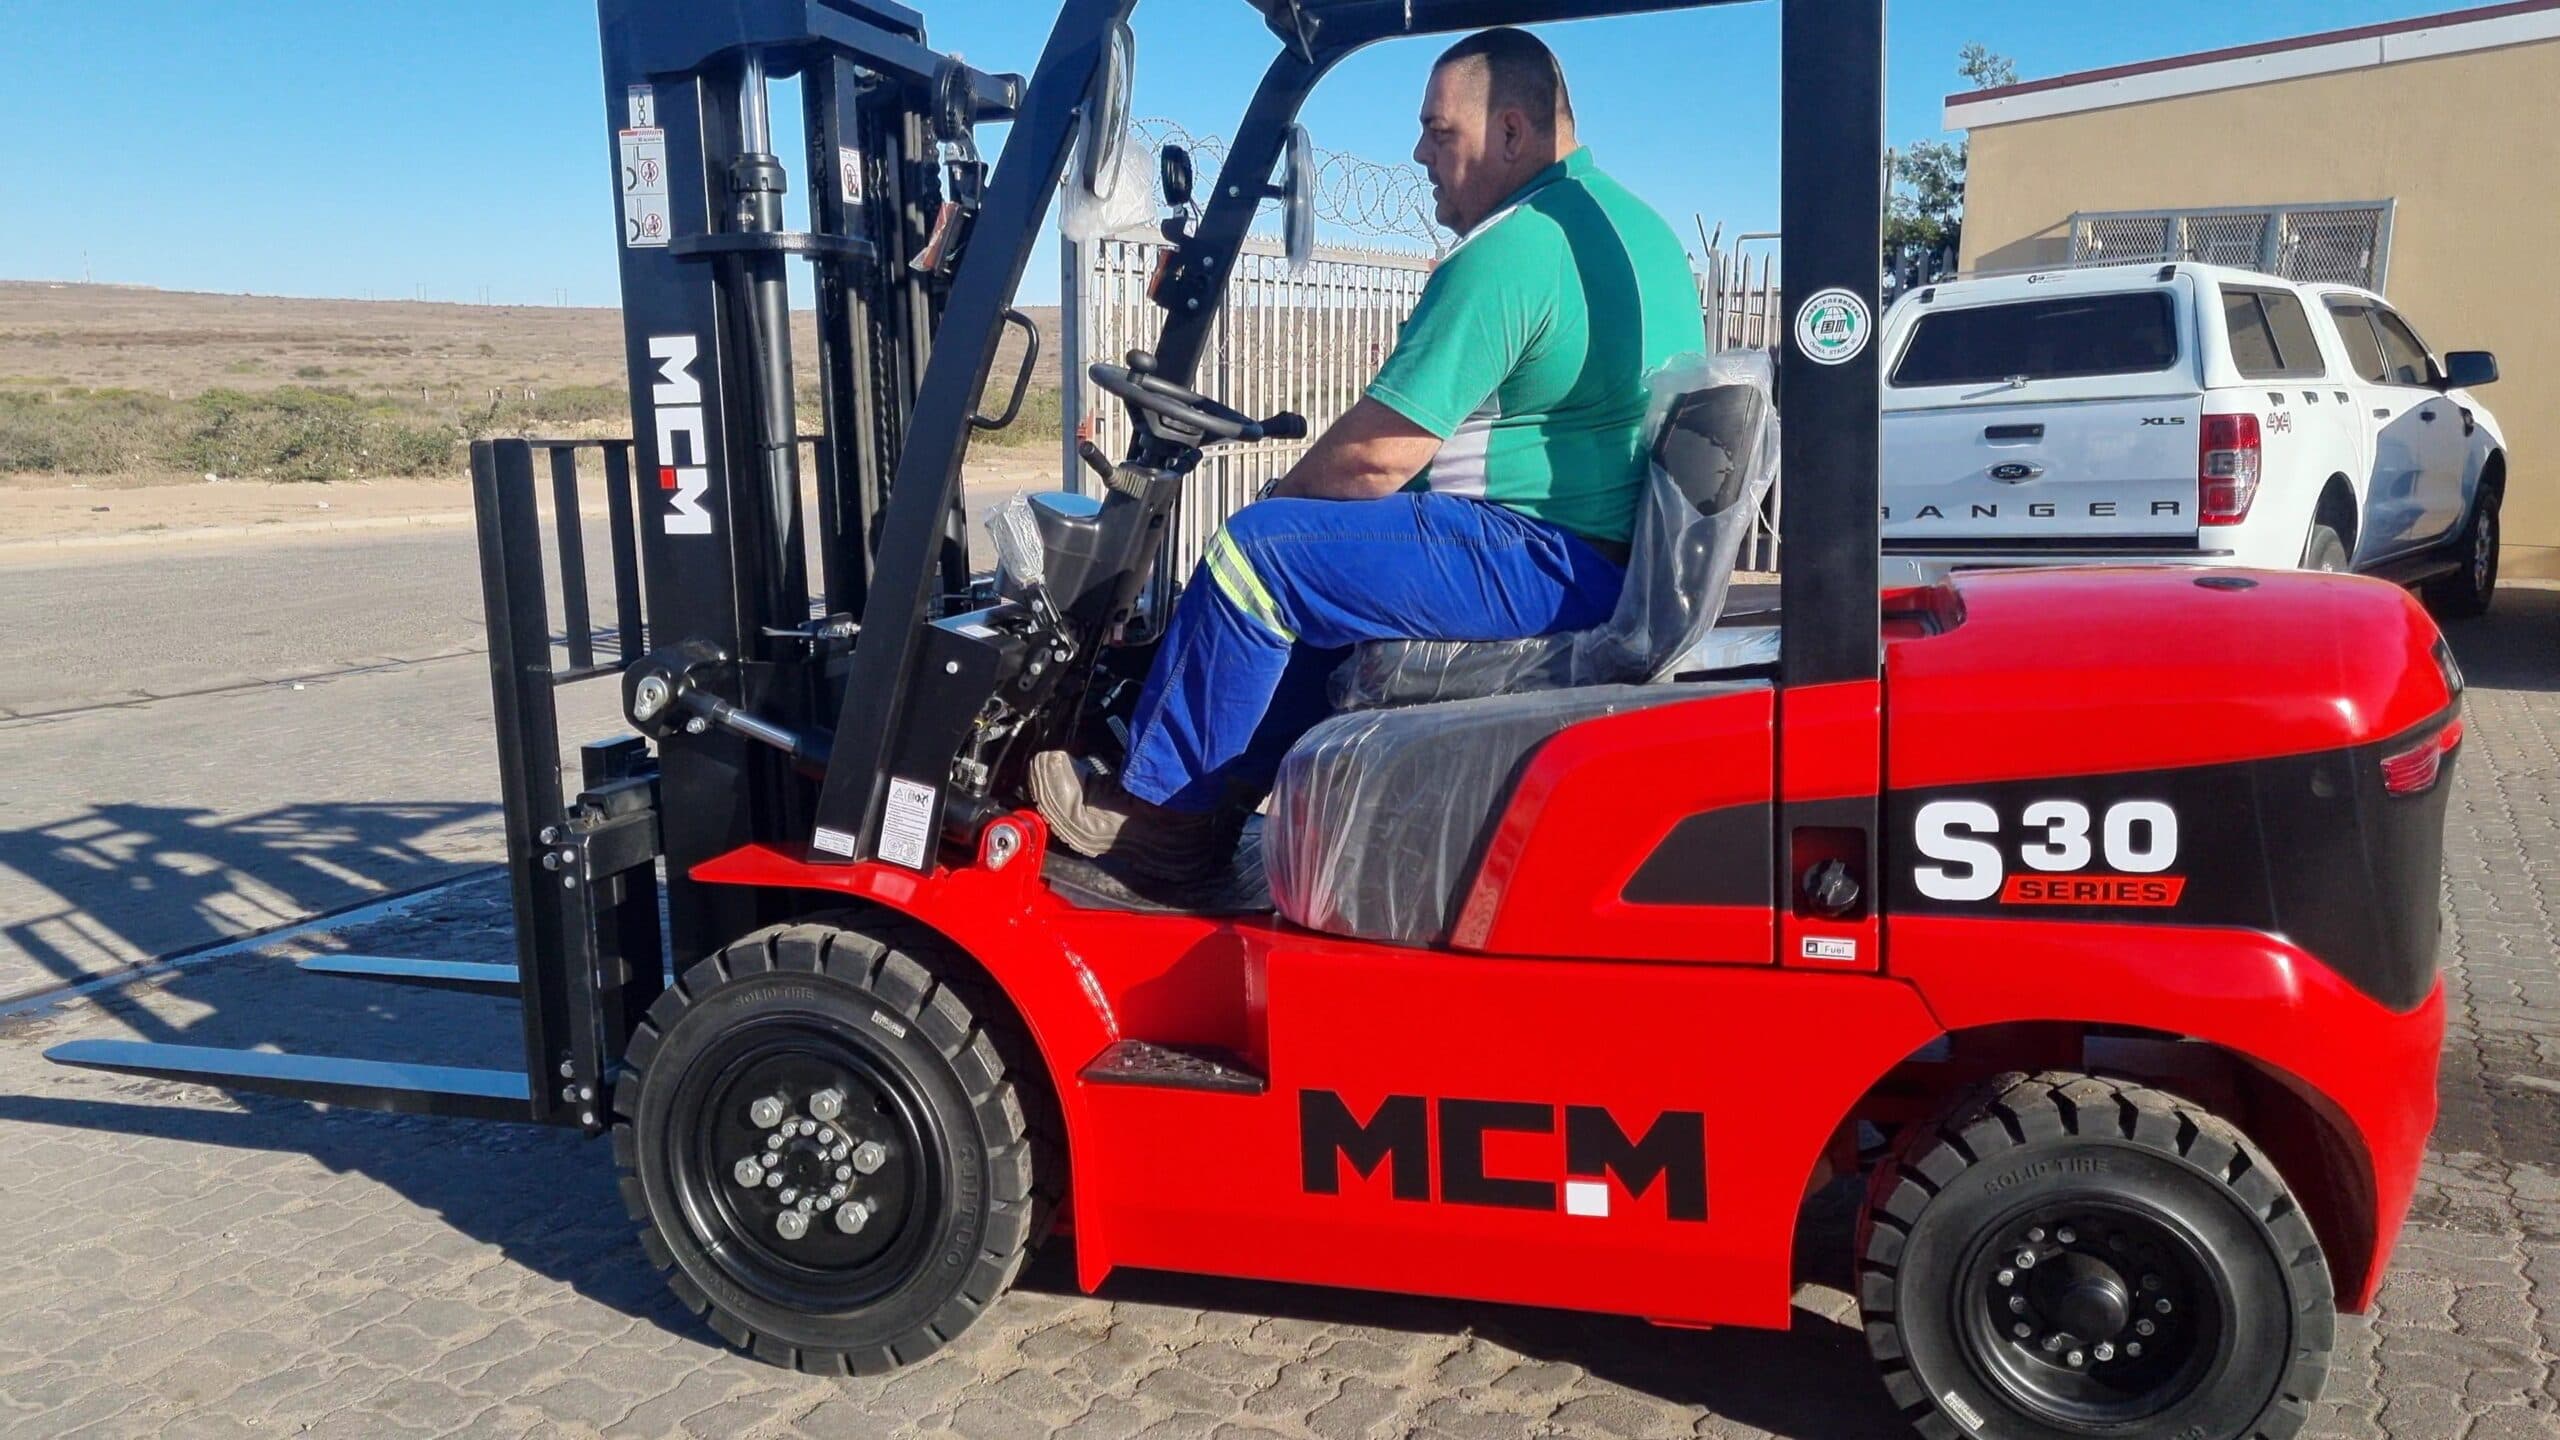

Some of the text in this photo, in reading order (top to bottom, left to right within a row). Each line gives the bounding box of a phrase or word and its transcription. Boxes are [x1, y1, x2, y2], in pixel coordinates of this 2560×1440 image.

[648, 335, 713, 535] MCM
[2140, 416, 2185, 426] XLS
[1914, 801, 2178, 900] S 30
[2019, 880, 2168, 901] SERIES
[1824, 944, 1845, 954] Fuel
[1298, 1088, 1709, 1223] MCM
[1984, 1162, 2049, 1195] SOLID
